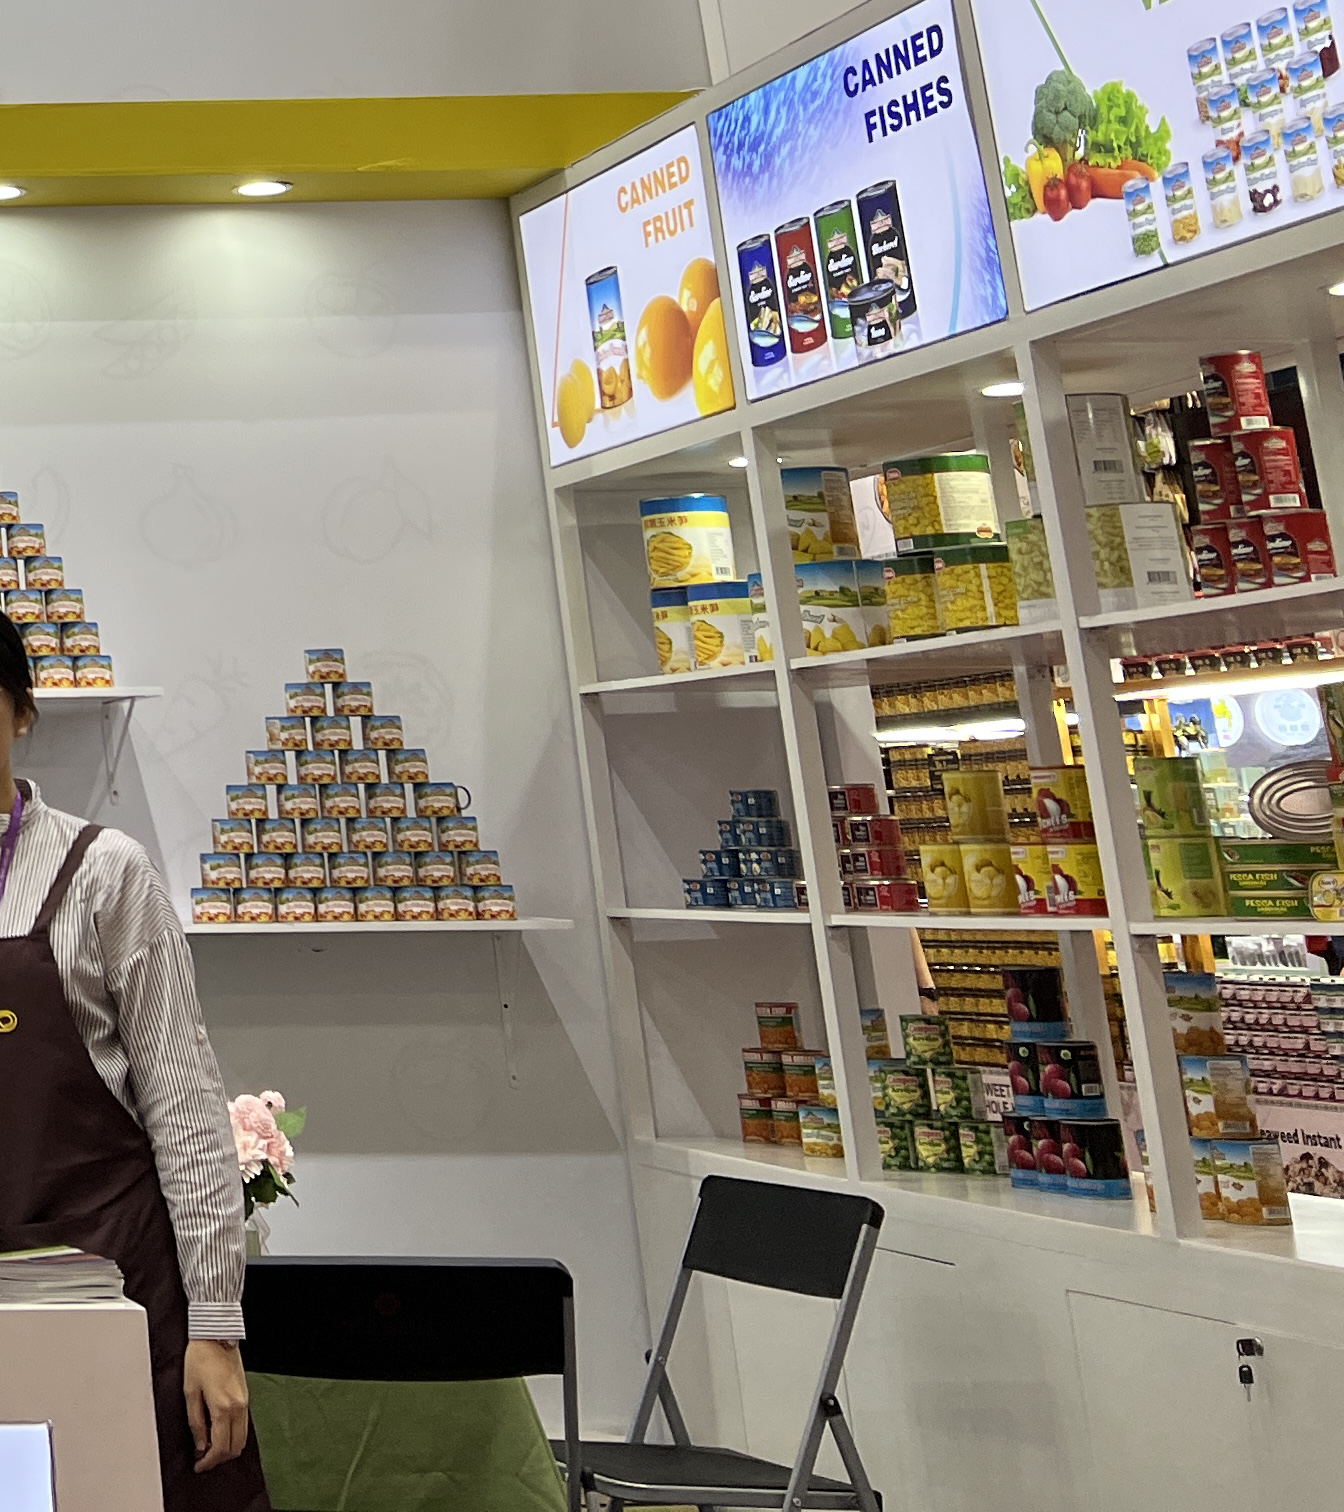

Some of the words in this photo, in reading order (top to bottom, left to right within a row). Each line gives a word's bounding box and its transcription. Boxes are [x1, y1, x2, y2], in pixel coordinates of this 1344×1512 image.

[842, 22, 945, 99] CANNED
[864, 75, 954, 144] FISHES
[616, 155, 692, 215] CANNED
[641, 198, 696, 249] FRUIT
[985, 1083, 1012, 1099] WEET
[1259, 1128, 1300, 1145] eaweed
